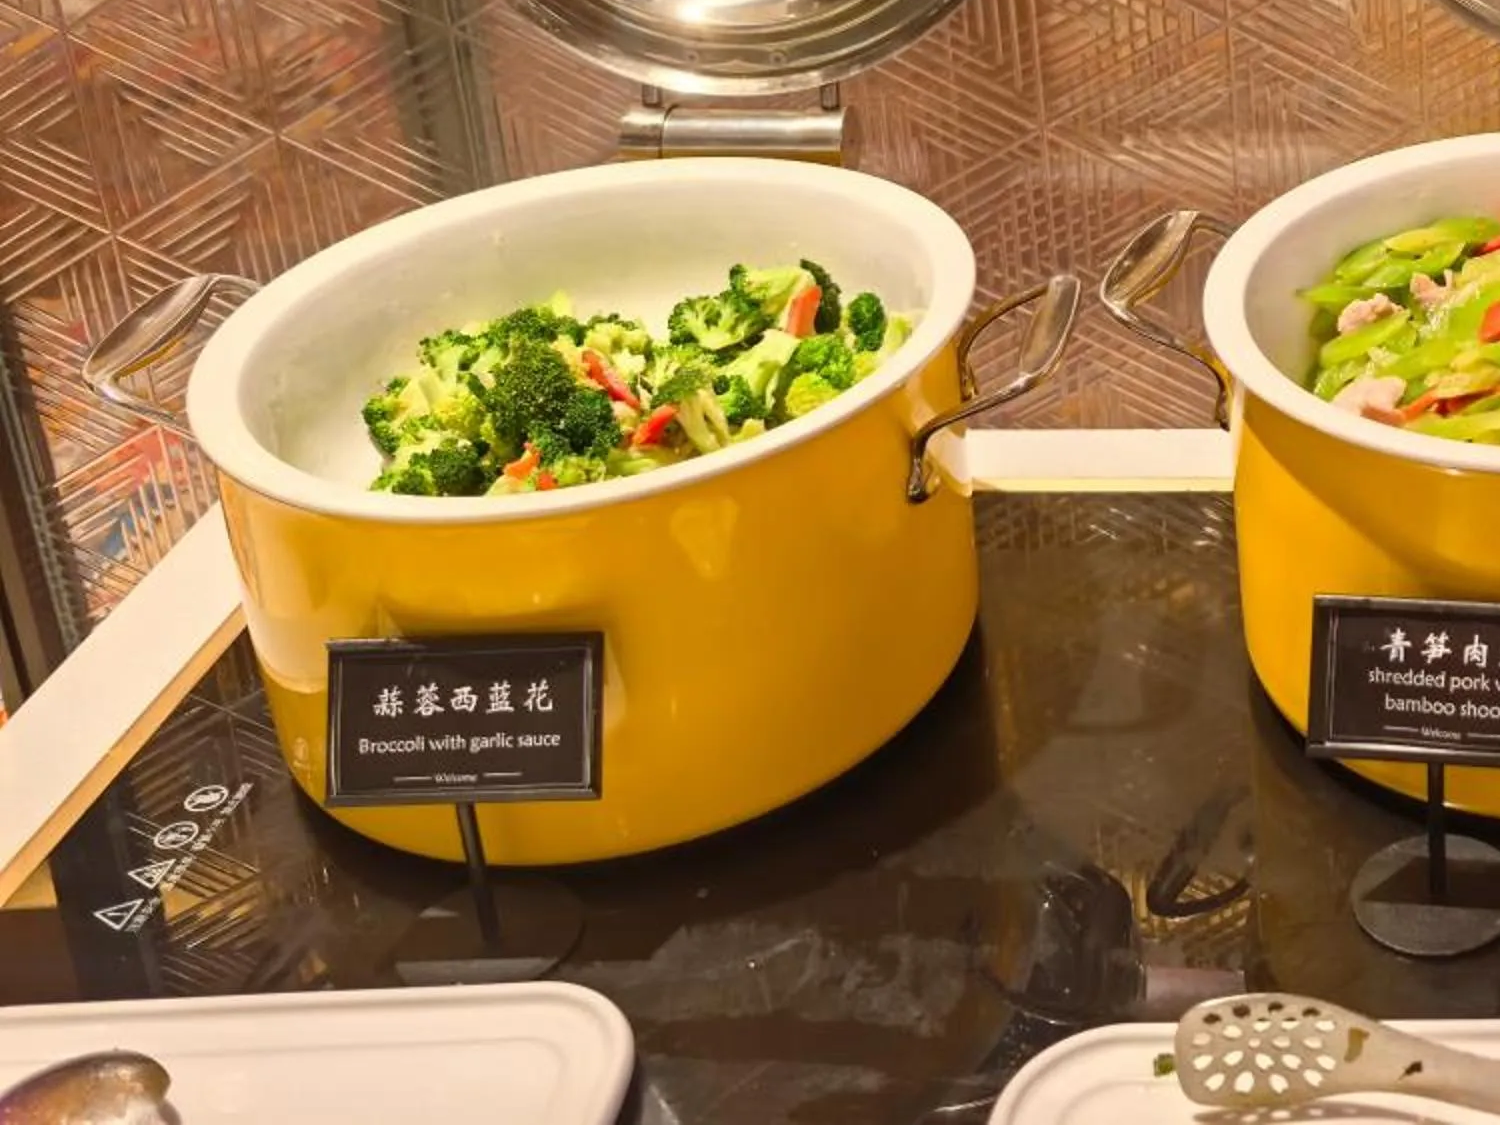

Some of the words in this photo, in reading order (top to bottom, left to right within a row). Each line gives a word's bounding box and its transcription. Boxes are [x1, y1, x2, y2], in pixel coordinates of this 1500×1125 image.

[1368, 667, 1445, 688] shredded
[1450, 673, 1490, 695] pork
[372, 679, 553, 717] 蒜蓉西蓝花
[1385, 694, 1455, 716] bamboo
[359, 735, 424, 754] Broccoli
[429, 734, 466, 751] with
[470, 732, 513, 754] garlic
[518, 732, 561, 748] sauce
